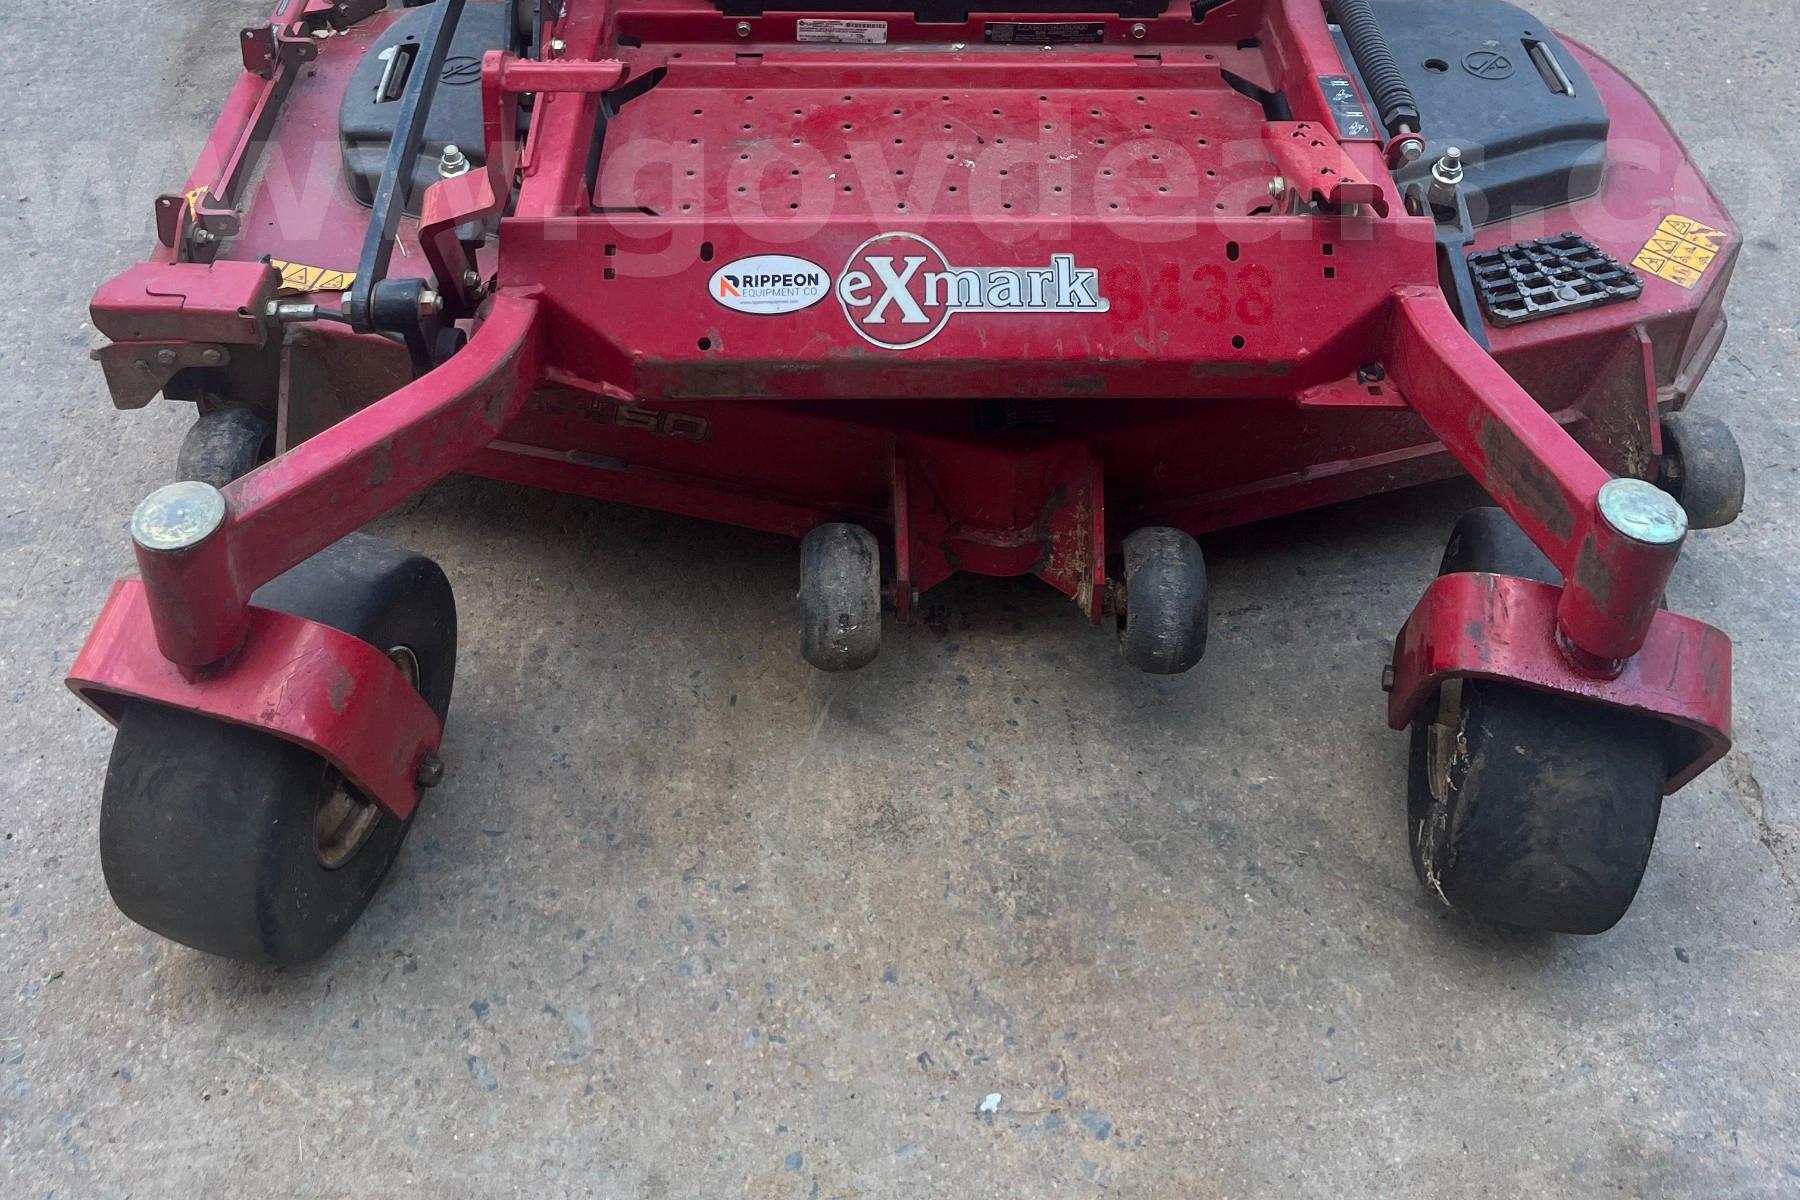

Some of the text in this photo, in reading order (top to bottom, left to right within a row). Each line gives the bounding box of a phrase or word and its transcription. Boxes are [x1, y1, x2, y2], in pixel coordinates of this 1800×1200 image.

[742, 273, 819, 288] RIPPEON
[742, 286, 818, 298] EQUIPMENT CO
[837, 249, 1101, 330] eXmark
